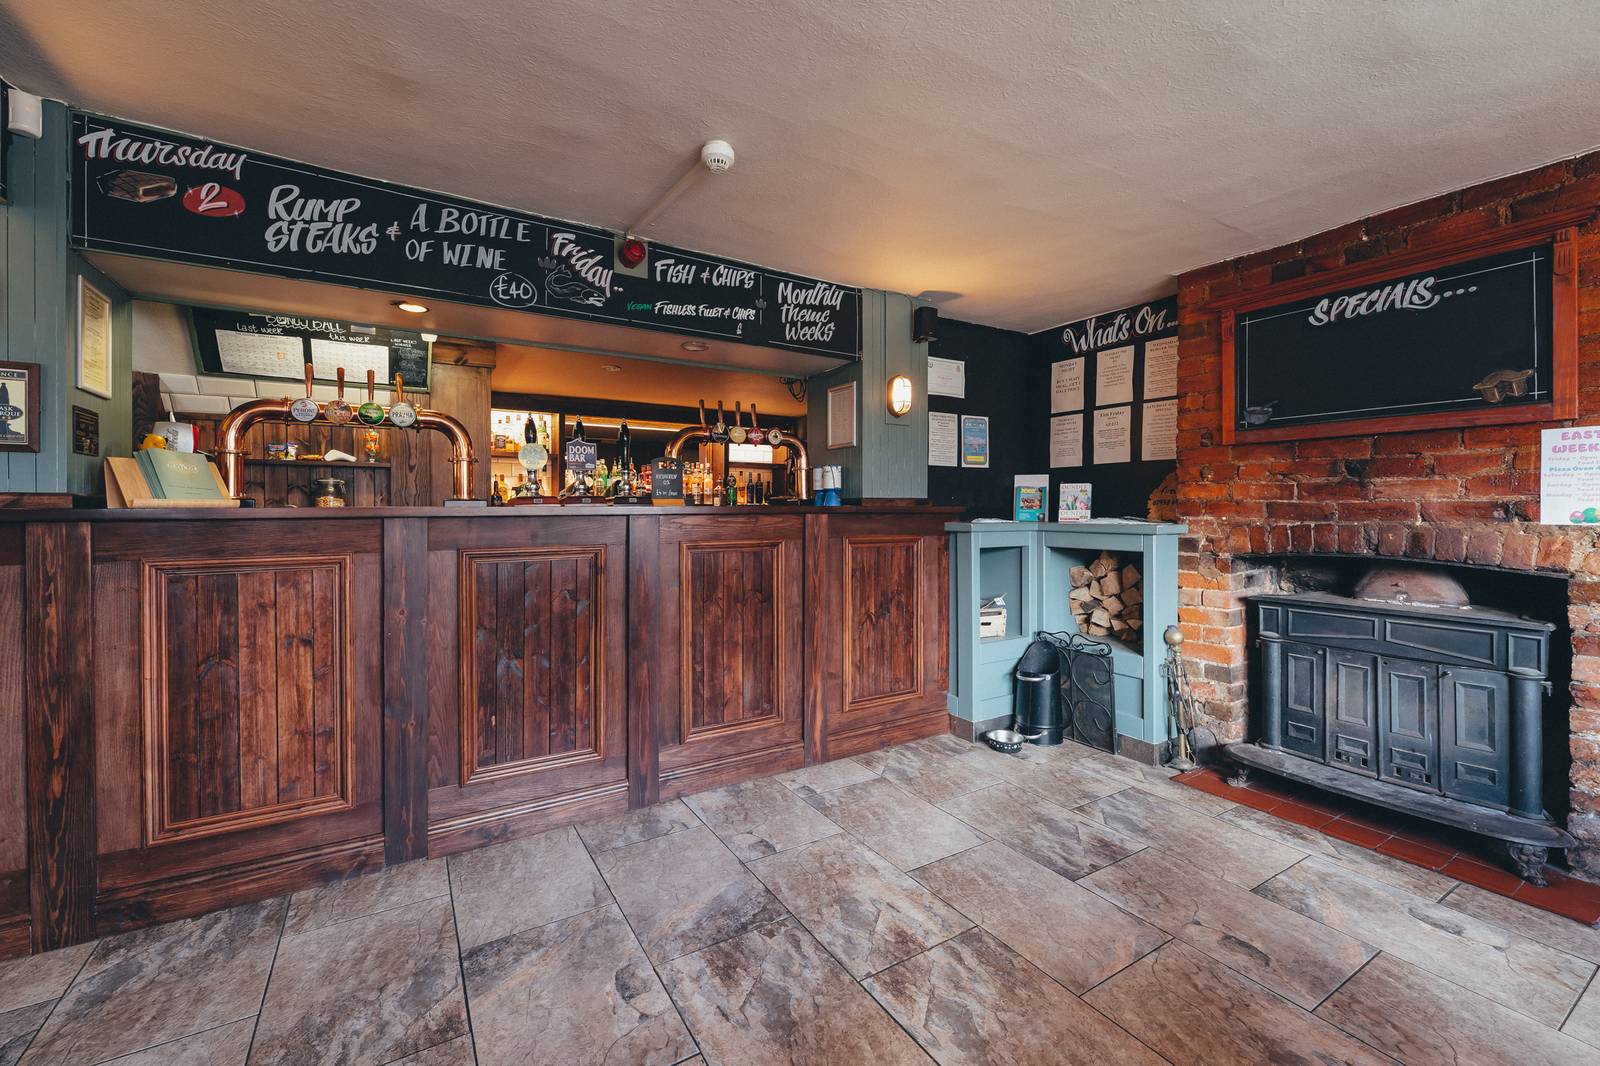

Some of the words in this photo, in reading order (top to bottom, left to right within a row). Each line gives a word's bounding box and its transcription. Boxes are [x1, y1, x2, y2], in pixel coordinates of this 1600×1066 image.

[78, 128, 247, 180] Thursday
[198, 182, 228, 213] 2
[410, 203, 431, 232] A
[434, 208, 531, 242] BOTTLE
[405, 239, 435, 262] OF
[442, 241, 508, 271] WINE
[494, 274, 533, 300] £40
[712, 265, 755, 289] CHIPS
[778, 282, 844, 311] Monthly
[780, 304, 830, 323] theme
[1063, 313, 1131, 353] What's
[569, 445, 595, 454] DOOM
[569, 454, 586, 462] BAR
